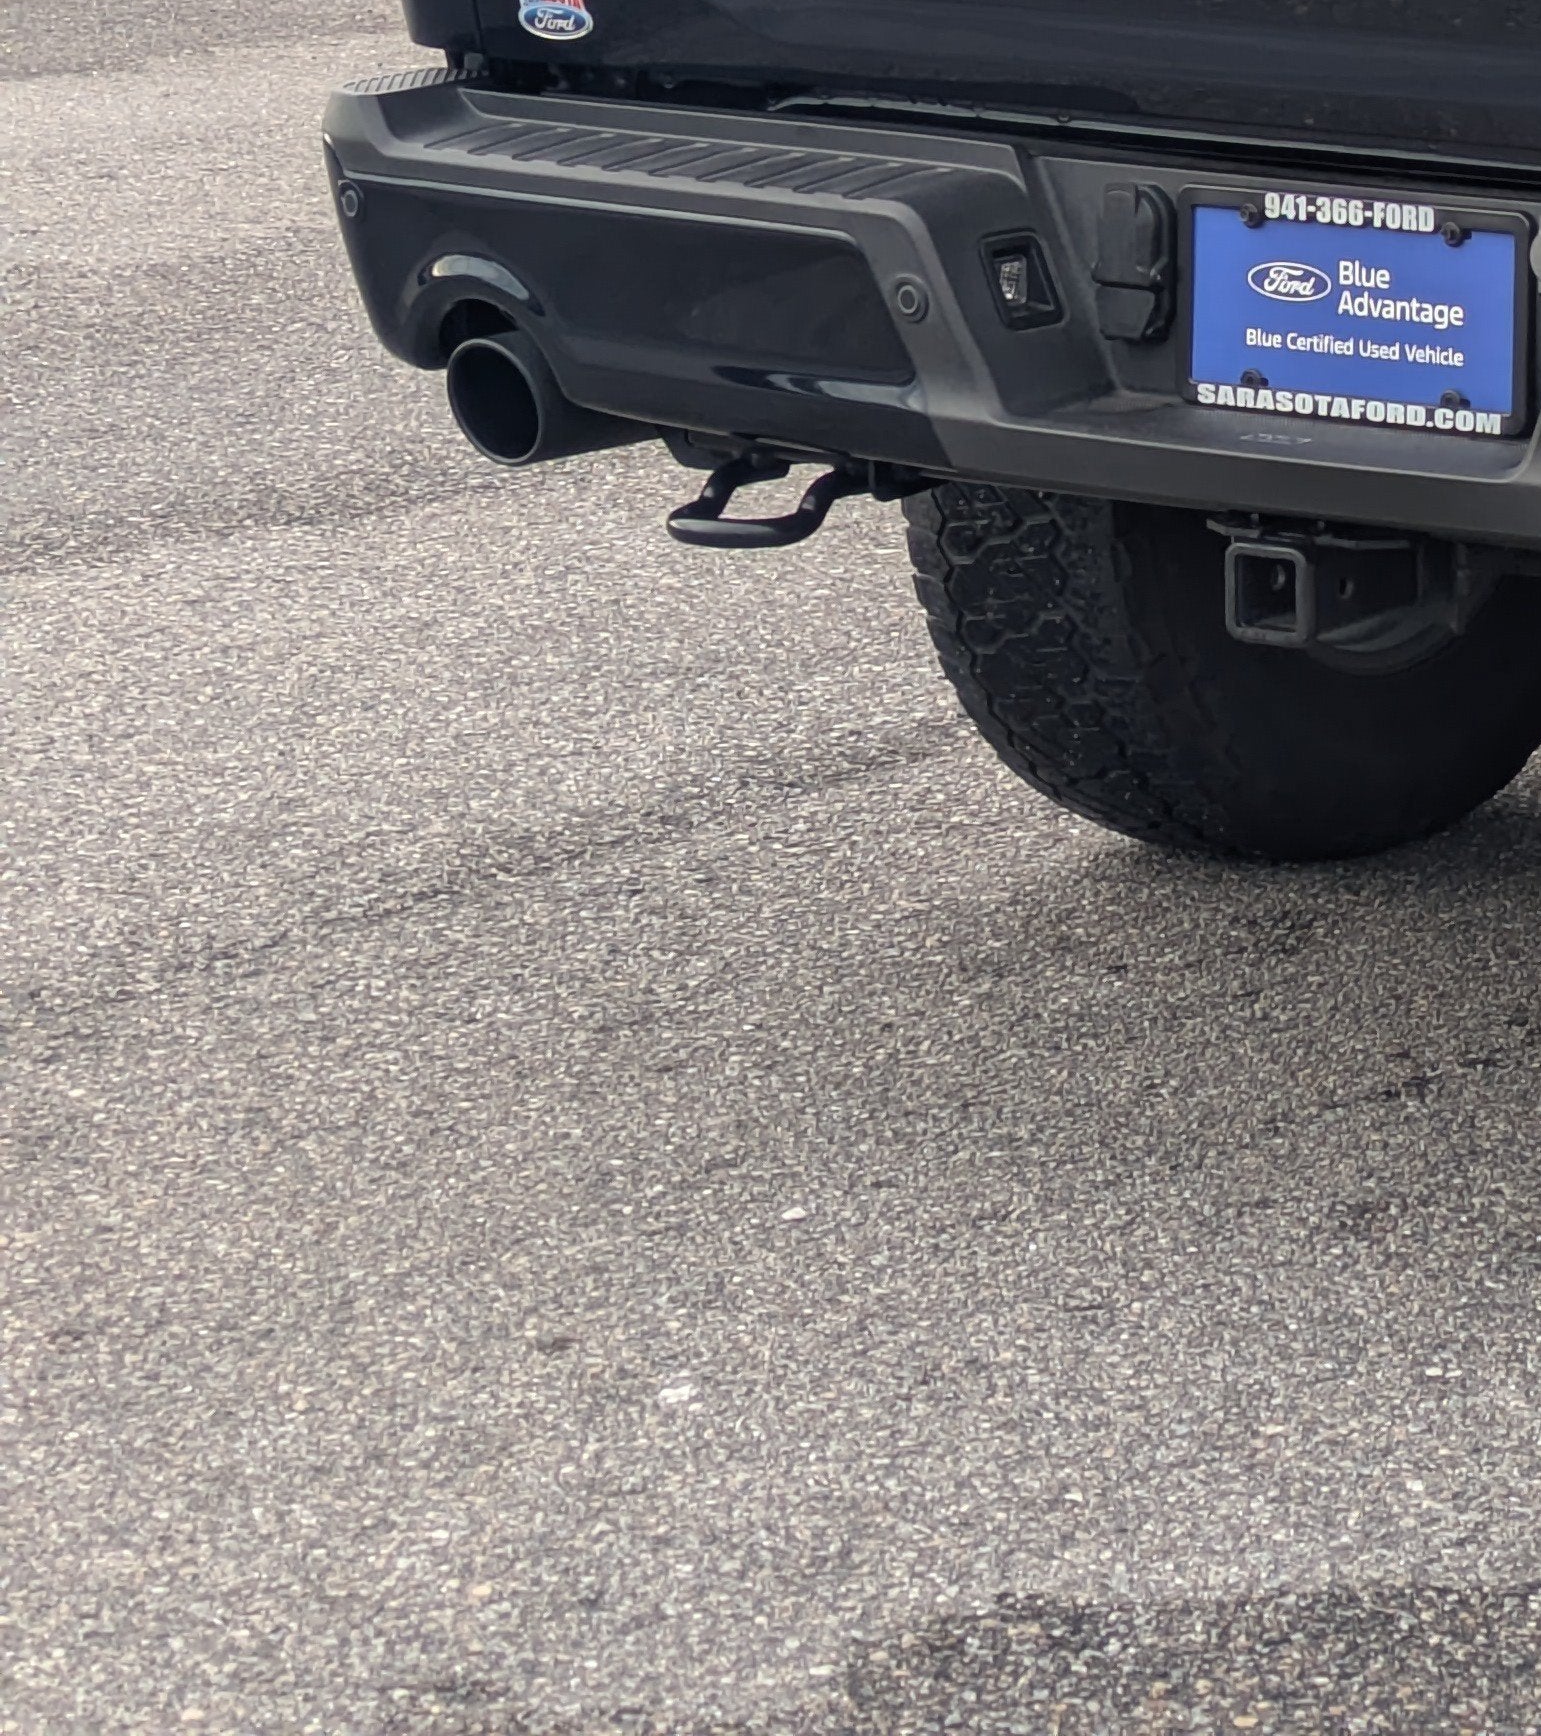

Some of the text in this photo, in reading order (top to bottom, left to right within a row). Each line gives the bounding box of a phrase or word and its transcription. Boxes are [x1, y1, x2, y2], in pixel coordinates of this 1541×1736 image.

[535, 7, 576, 31] Ford
[1264, 192, 1435, 233] 941-366-FORD
[1262, 265, 1316, 297] Ford
[1338, 260, 1390, 290] Blue
[1337, 290, 1464, 329] Advantage
[1245, 327, 1464, 367] Blue Certified Used Vehicle
[1196, 382, 1502, 435] SARASOTAFORD.COM
